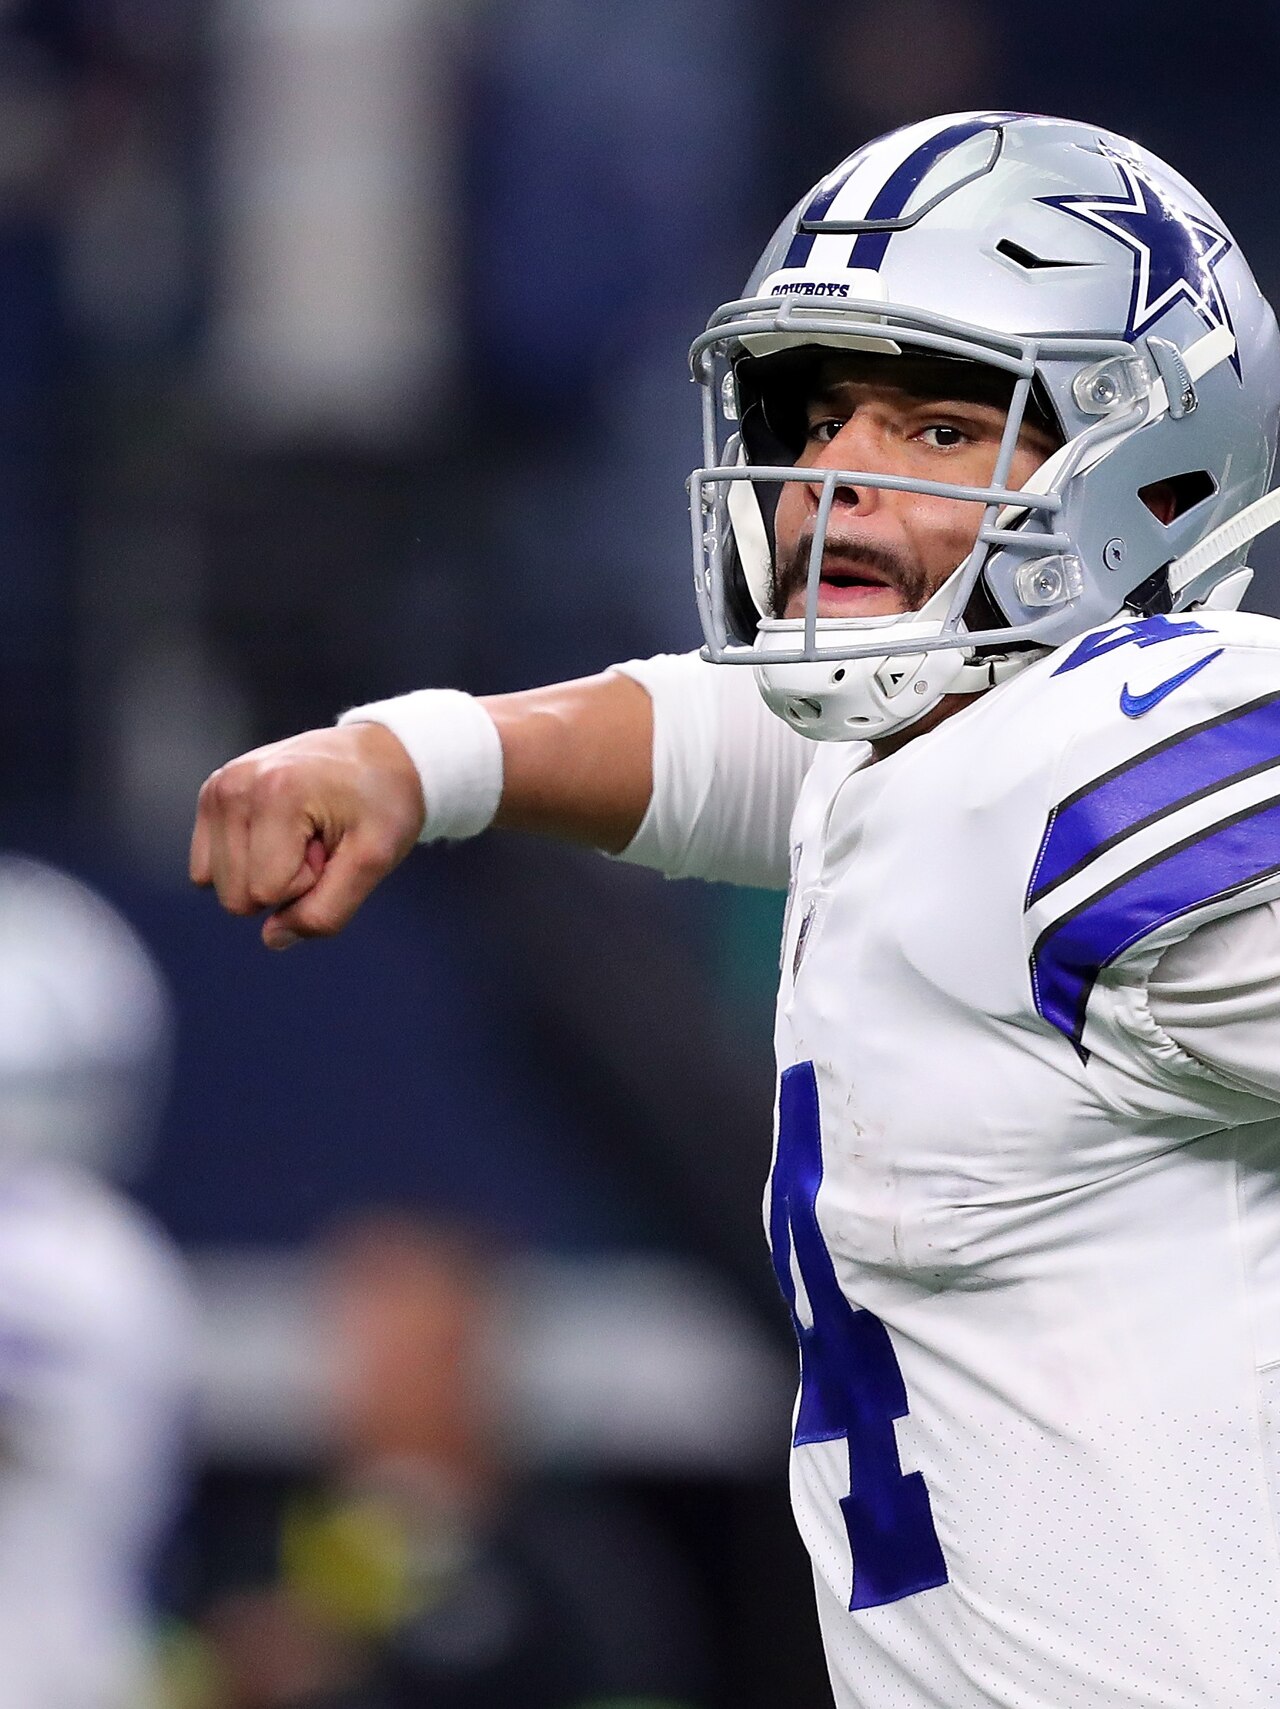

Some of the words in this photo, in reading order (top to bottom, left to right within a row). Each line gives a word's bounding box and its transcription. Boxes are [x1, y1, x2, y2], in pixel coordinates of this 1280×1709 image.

[771, 282, 850, 297] COWBOYS
[1049, 613, 1219, 678] 4
[769, 1060, 949, 1612] 4
